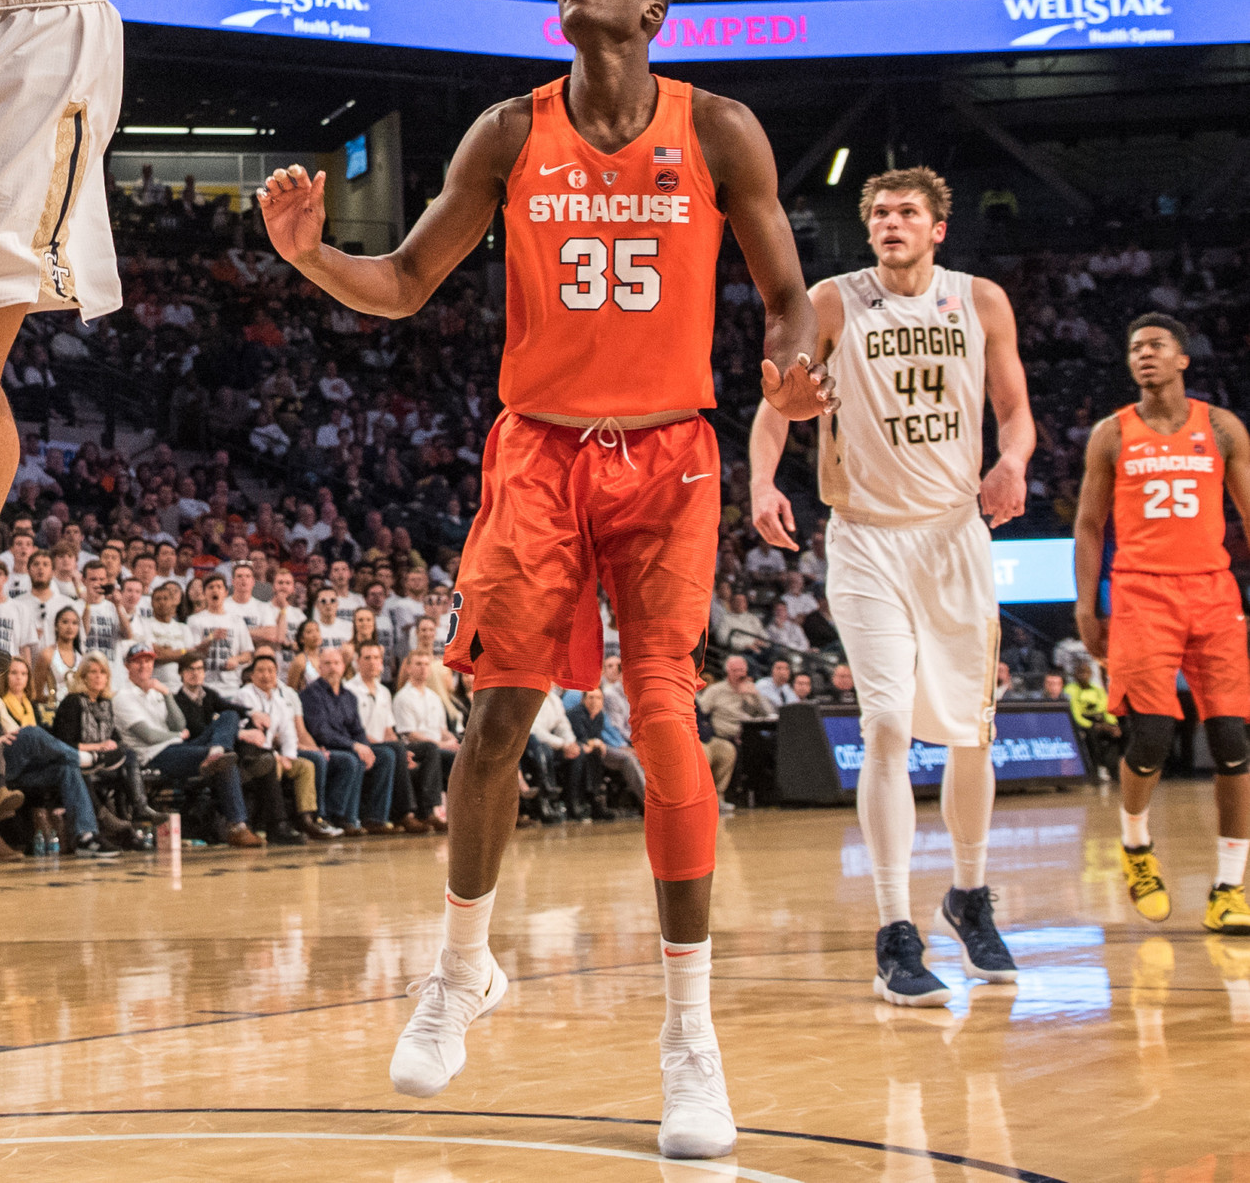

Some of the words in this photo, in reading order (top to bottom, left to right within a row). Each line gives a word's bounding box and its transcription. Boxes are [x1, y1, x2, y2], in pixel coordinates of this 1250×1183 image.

[655, 15, 808, 48] UMPED!
[528, 193, 691, 224] SYRACUSE
[559, 237, 662, 313] 35
[865, 326, 967, 361] GEORGIA
[894, 364, 945, 406] 44
[883, 410, 960, 447] TECH
[1123, 454, 1215, 476] SYRACUSE
[1142, 478, 1200, 520] 25
